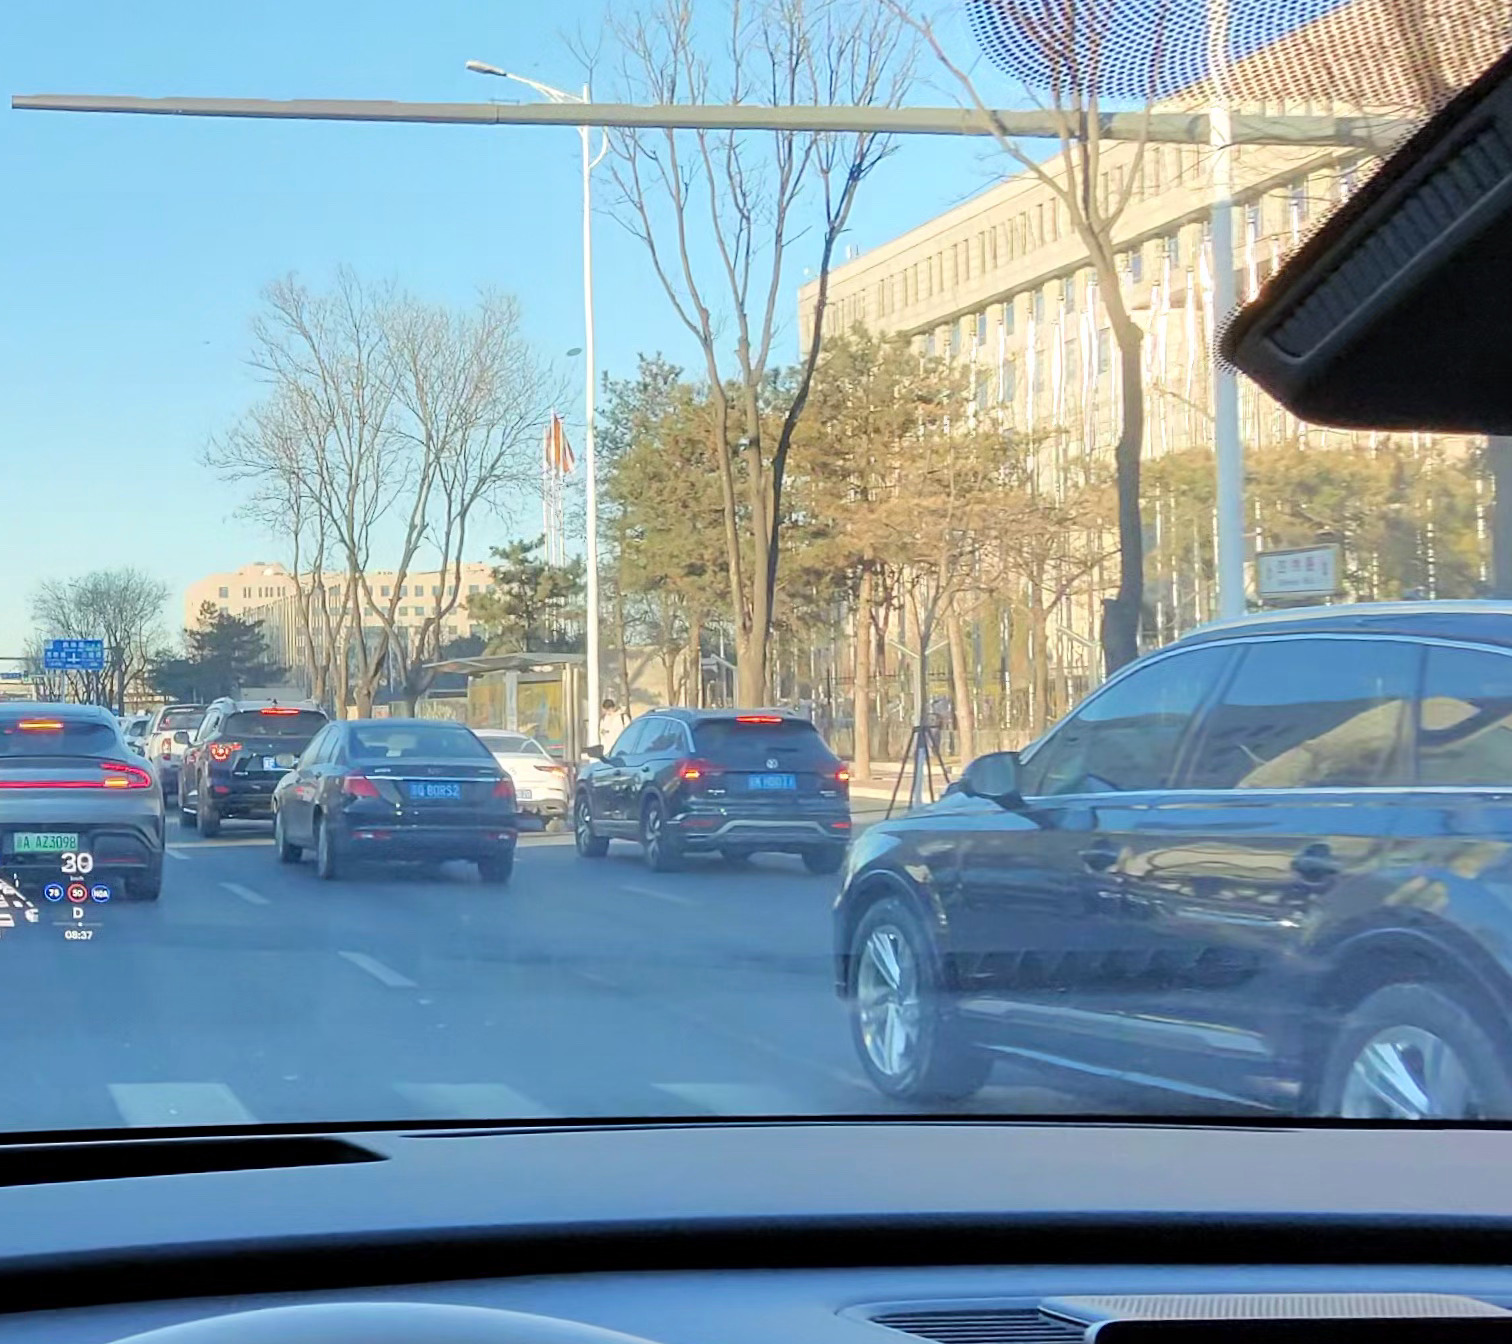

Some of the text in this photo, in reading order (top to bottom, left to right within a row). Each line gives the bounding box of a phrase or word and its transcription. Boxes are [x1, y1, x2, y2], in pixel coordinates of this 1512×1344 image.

[35, 836, 76, 848] AZ3098
[61, 852, 93, 874] 30
[72, 889, 83, 897] 50
[73, 907, 84, 919] D
